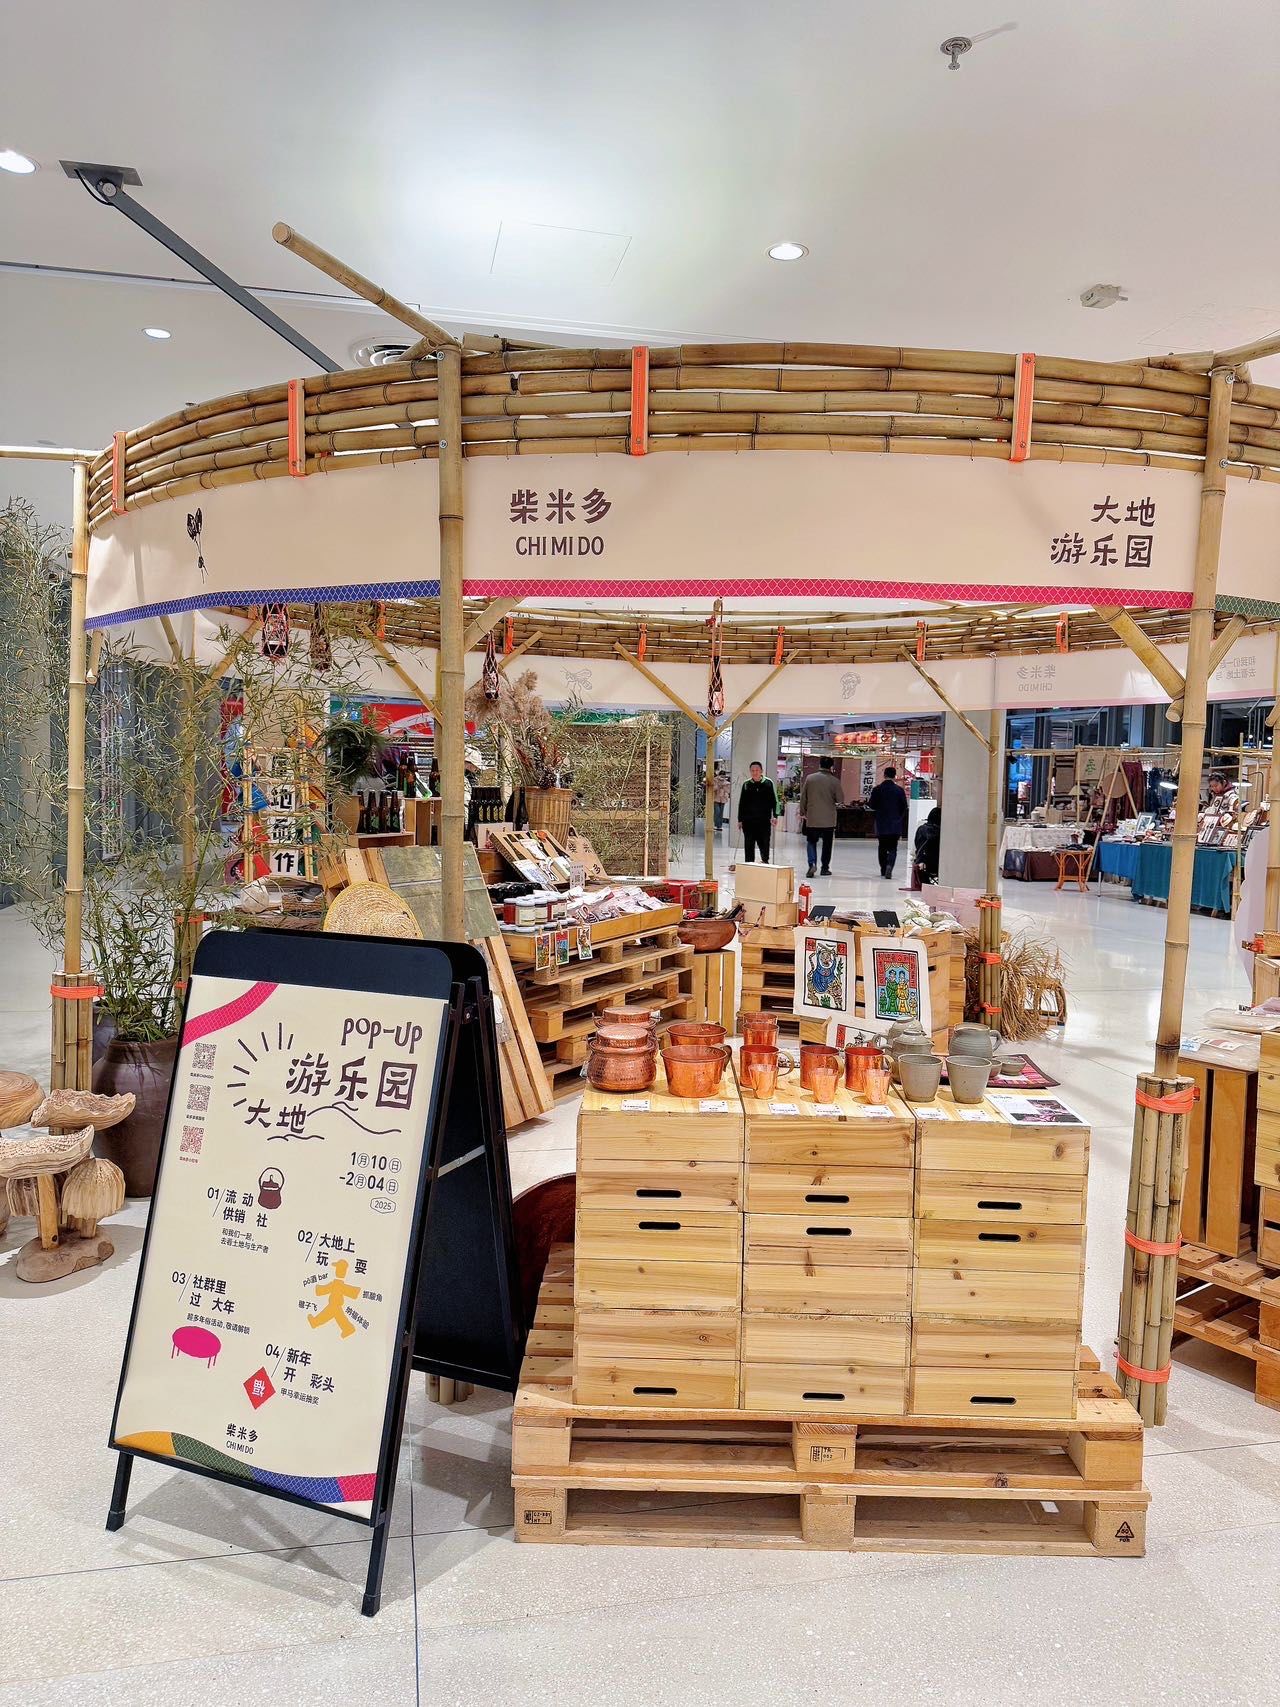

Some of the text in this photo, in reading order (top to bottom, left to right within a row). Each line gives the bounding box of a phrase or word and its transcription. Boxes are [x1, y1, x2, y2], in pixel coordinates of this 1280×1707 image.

[509, 488, 612, 524] 柴米多
[1090, 495, 1155, 527] 大地
[1050, 532, 1153, 568] 游乐园
[286, 1052, 418, 1110] 游乐园
[244, 1099, 306, 1133] 大地
[374, 1200, 392, 1211] 2025
[318, 1233, 356, 1254] 大地上
[193, 1274, 227, 1295] 社群里
[286, 1347, 312, 1367] 新年
[226, 1423, 258, 1442] 柴米多
